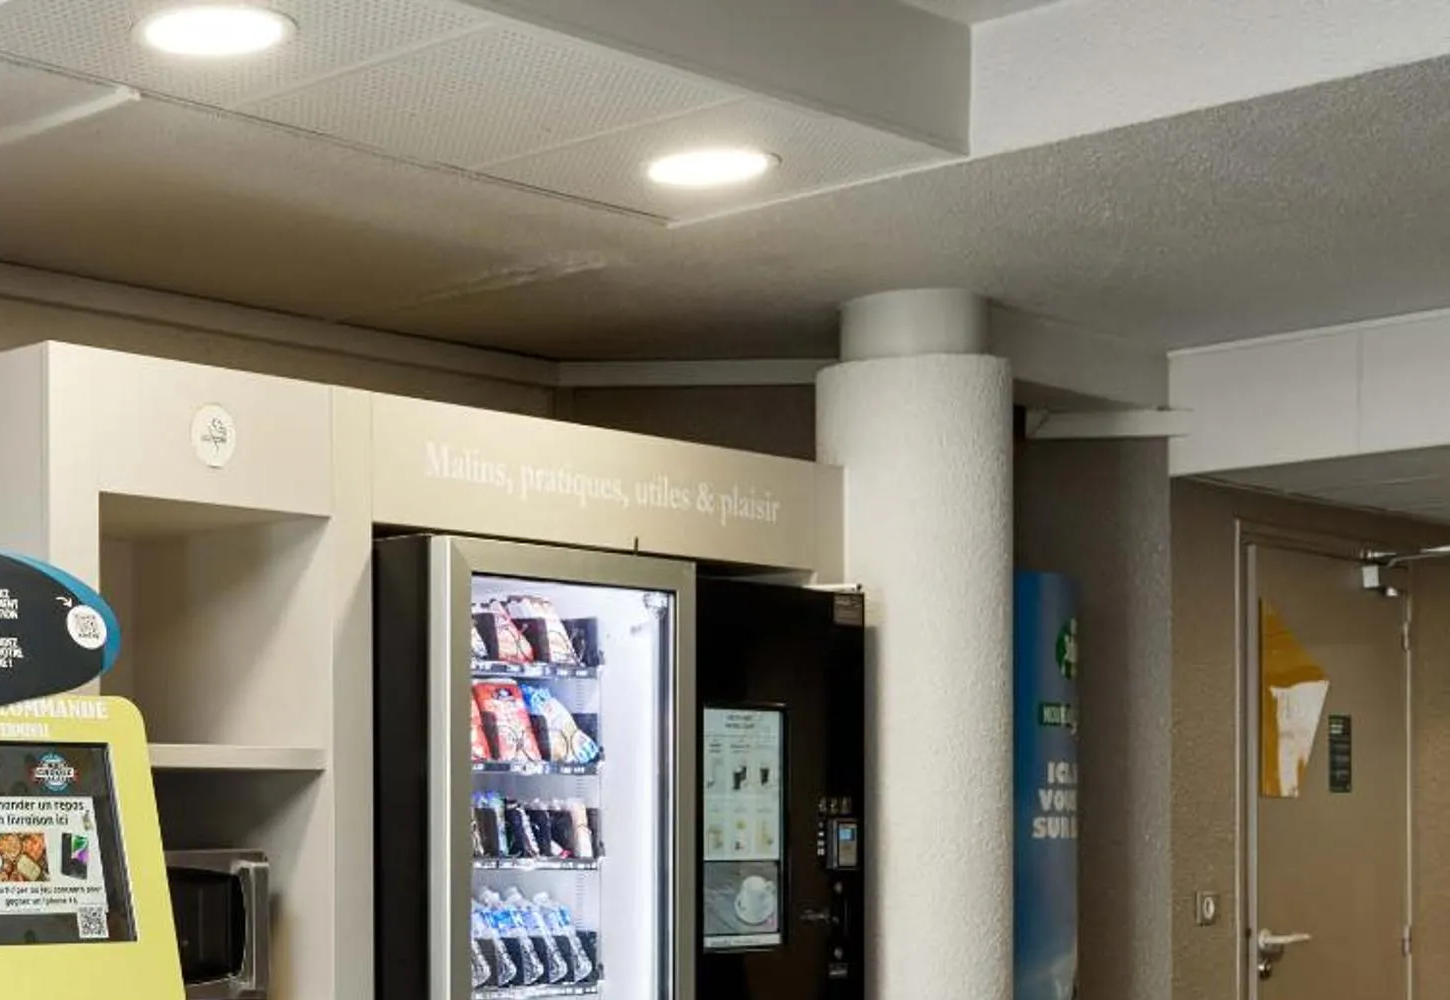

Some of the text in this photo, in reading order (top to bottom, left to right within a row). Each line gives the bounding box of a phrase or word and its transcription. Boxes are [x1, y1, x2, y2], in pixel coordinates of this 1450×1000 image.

[425, 440, 780, 527] Malins, pratiques, utiles & plaisir
[38, 801, 52, 811] un
[54, 801, 84, 813] repas
[7, 813, 54, 826] livraison
[56, 814, 69, 826] ici
